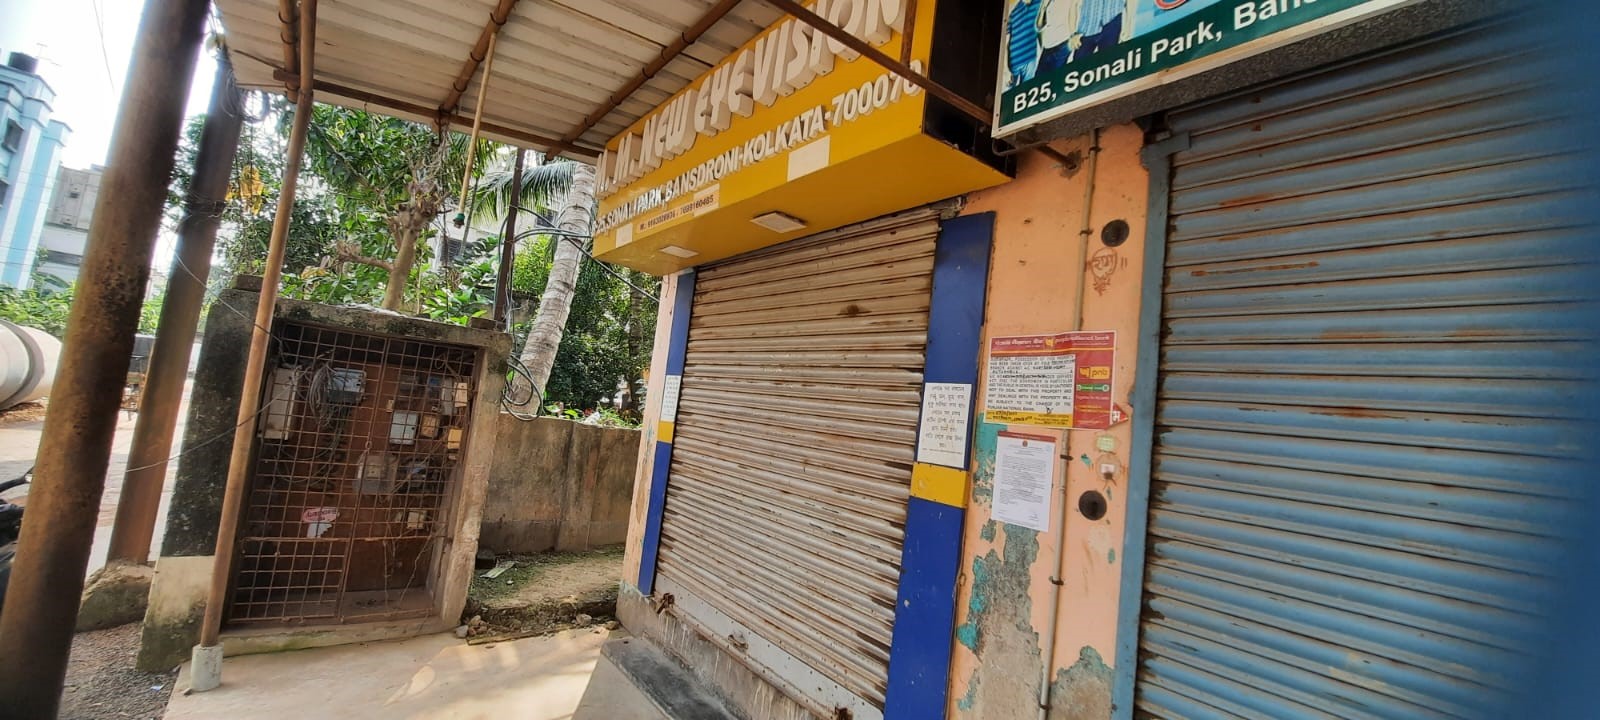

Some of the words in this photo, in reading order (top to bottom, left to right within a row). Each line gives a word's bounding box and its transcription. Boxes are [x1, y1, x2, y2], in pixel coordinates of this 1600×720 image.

[639, 89, 695, 169] NEW
[694, 49, 752, 136] EYE
[1013, 82, 1056, 113] B25,
[1064, 48, 1142, 93] Sonali
[1151, 21, 1222, 63] Park,
[1092, 368, 1108, 377] pnb
